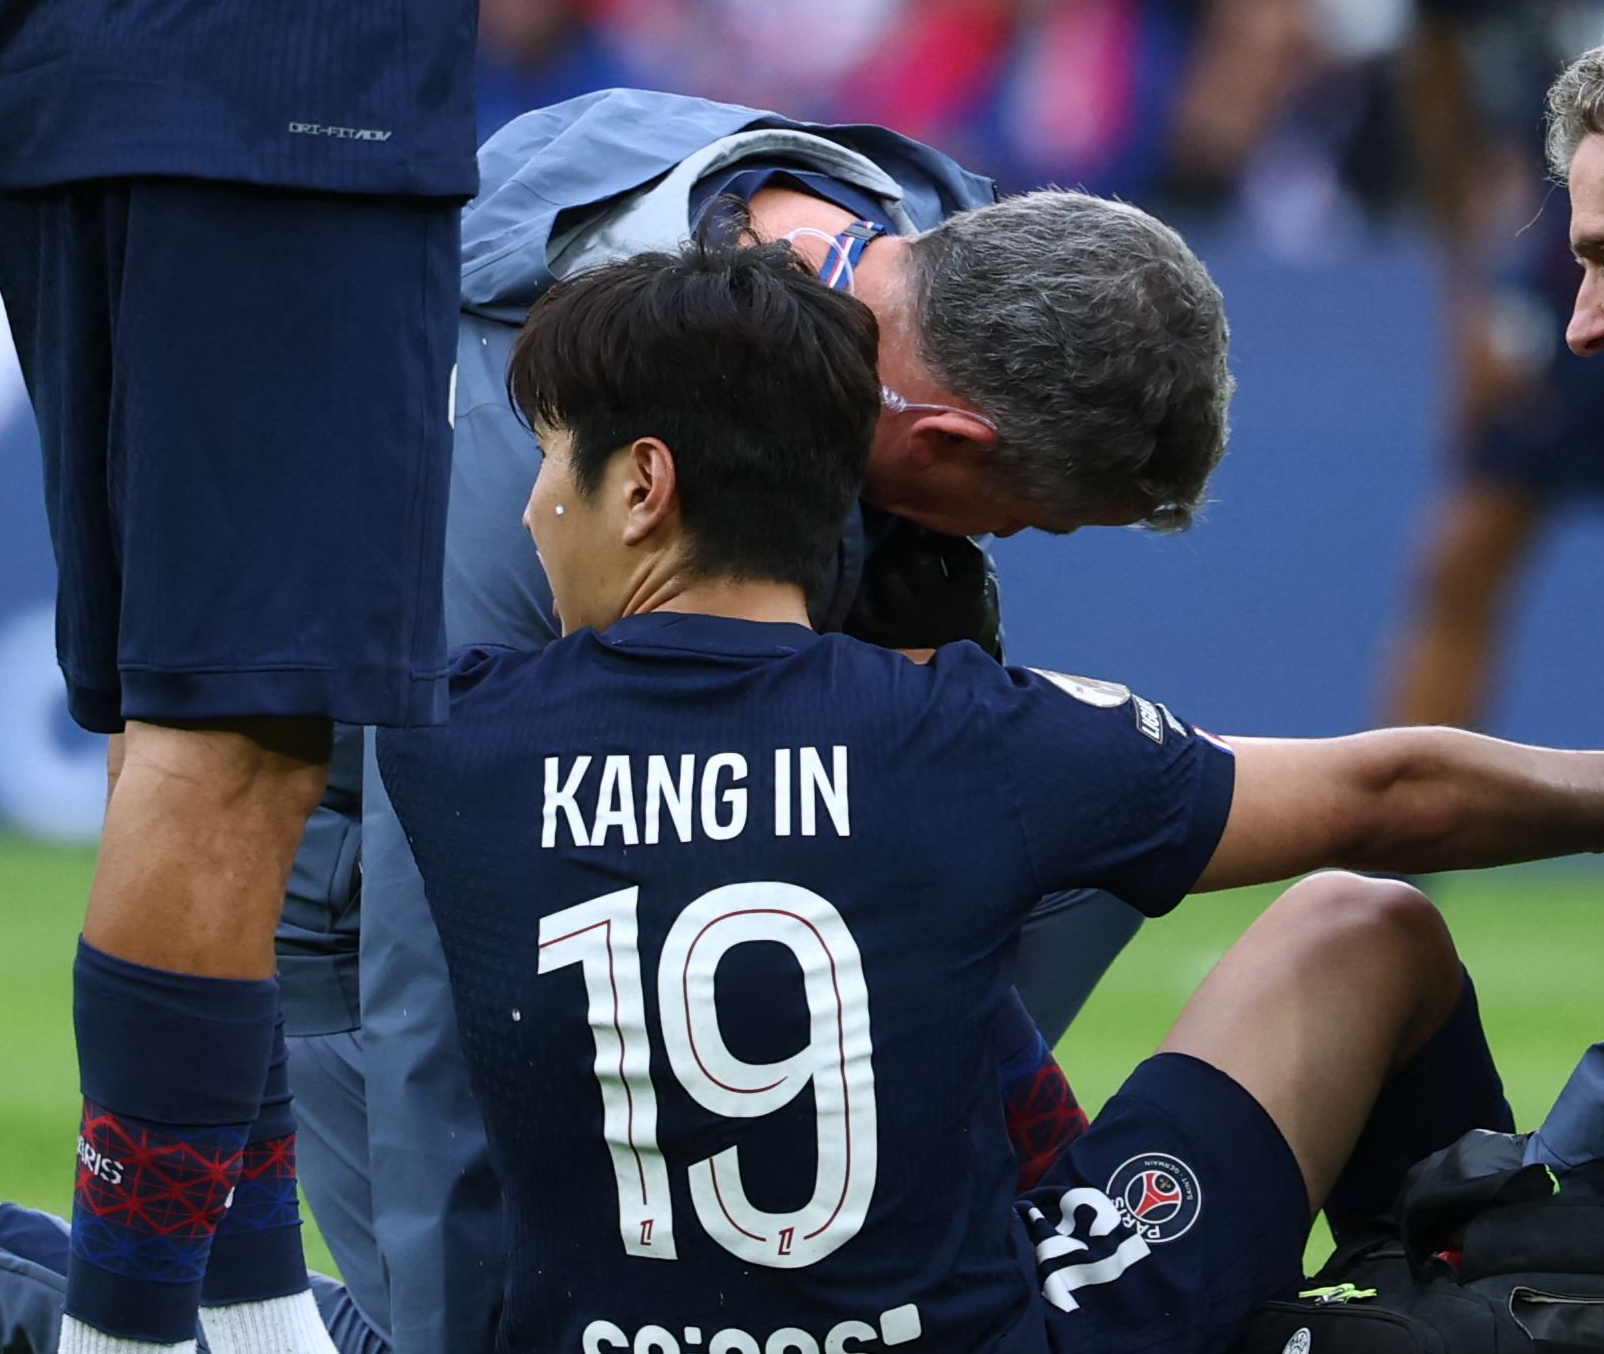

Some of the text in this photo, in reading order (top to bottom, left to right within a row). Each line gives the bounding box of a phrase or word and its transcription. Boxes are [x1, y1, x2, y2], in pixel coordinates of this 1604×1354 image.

[541, 745, 851, 847] KANG IN
[537, 881, 879, 1269] 19
